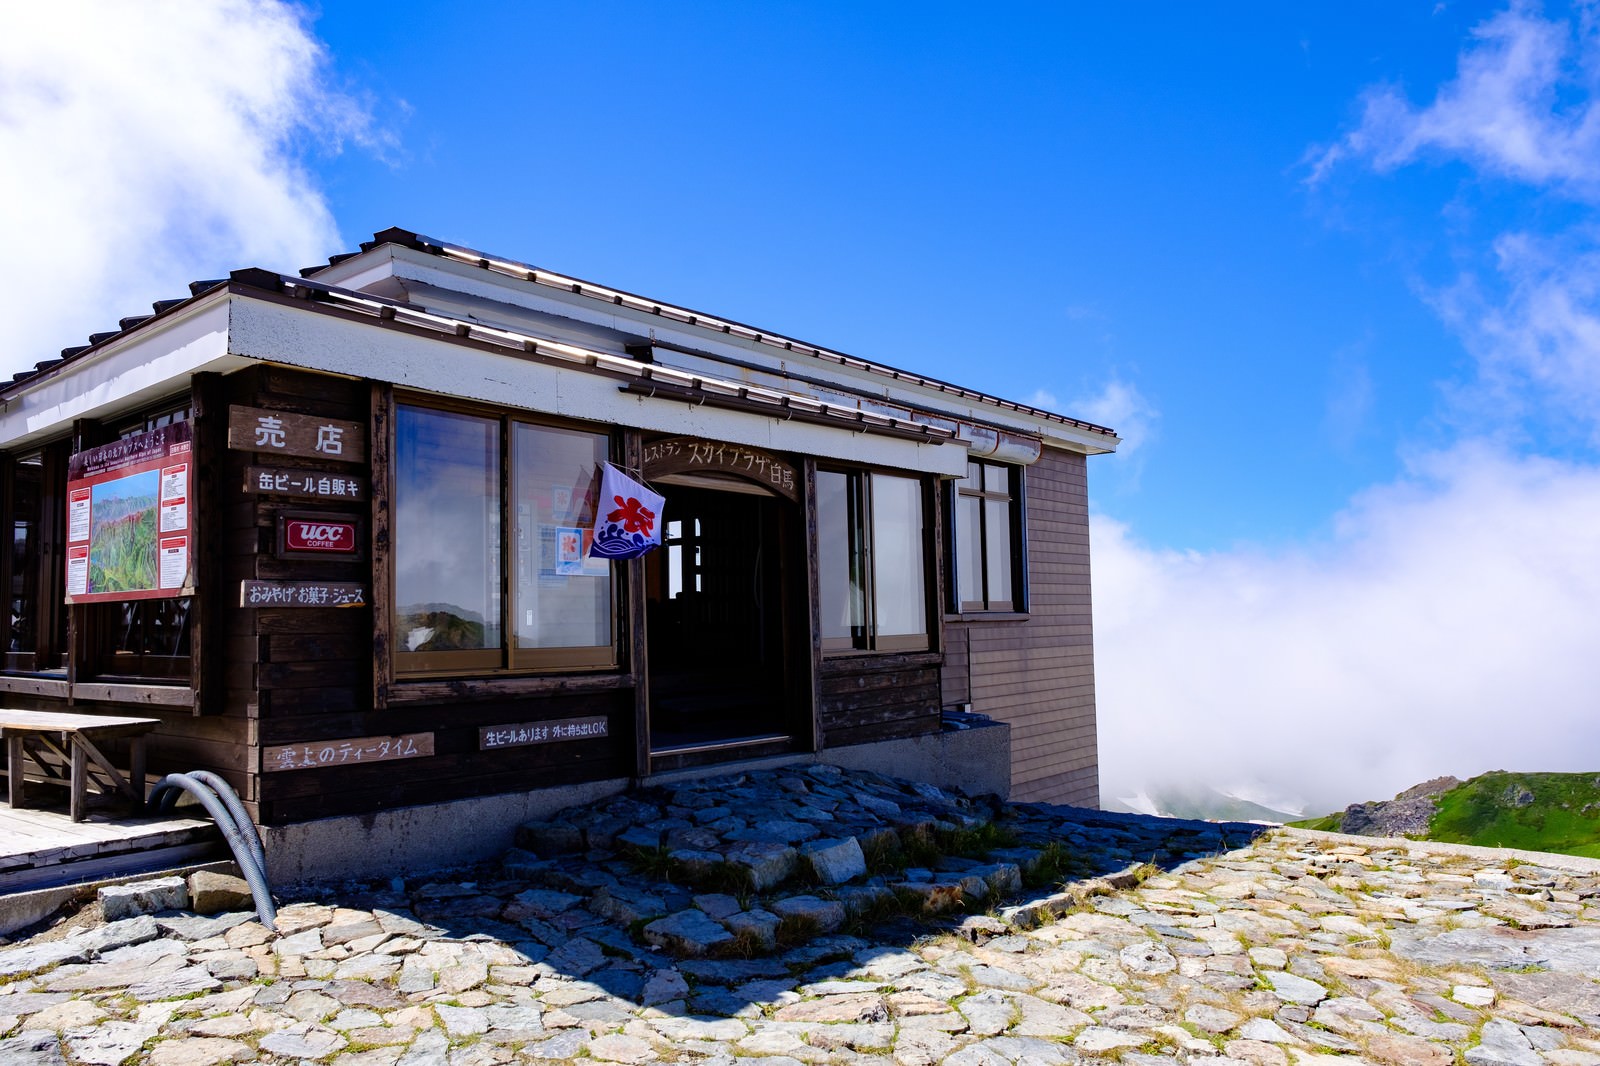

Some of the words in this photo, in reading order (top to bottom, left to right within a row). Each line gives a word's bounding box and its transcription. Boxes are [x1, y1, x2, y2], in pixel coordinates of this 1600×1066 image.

[644, 442, 682, 463] レストラン
[259, 472, 359, 497] 缶ビール自販キ
[300, 524, 344, 541] UCC
[306, 540, 334, 548] COFFEE
[486, 725, 549, 747] 生ビールあります
[277, 738, 418, 769] 雲上のティータイム
